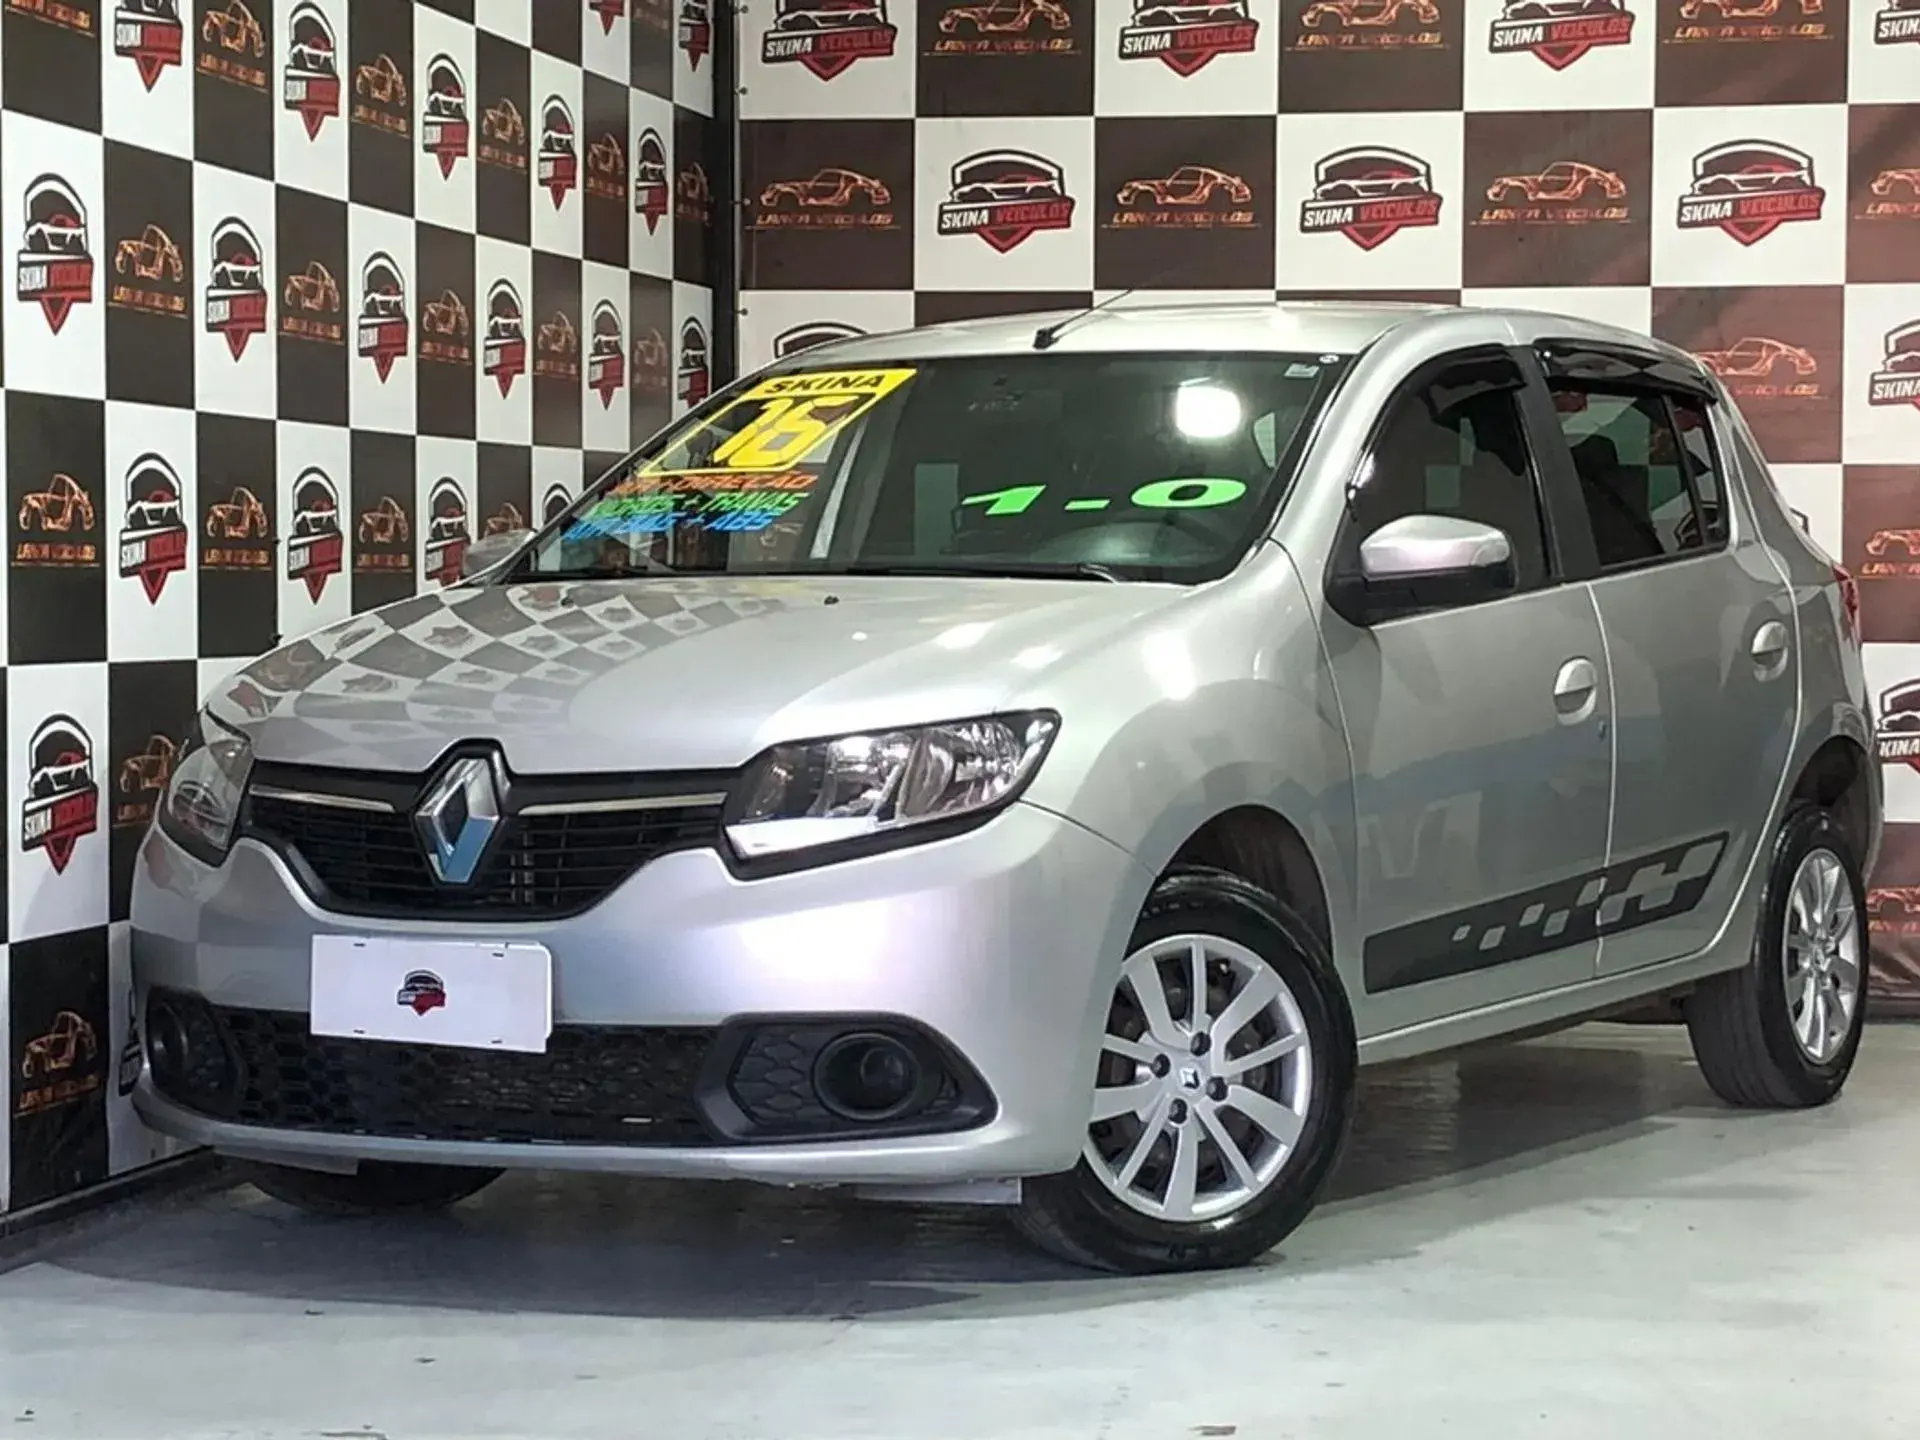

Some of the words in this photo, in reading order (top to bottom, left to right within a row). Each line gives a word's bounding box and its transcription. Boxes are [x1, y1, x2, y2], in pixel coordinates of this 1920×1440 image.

[1493, 25, 1544, 47] SKINA
[1878, 18, 1920, 38] SKIN
[766, 37, 813, 57] SKINA
[1123, 32, 1171, 53] SKINA
[941, 208, 989, 229] SKINA
[1303, 206, 1353, 227] SKINA
[1680, 200, 1732, 221] SKINA
[764, 374, 886, 394] SKINA
[713, 396, 859, 467] 16
[1878, 738, 1920, 757] KINA
